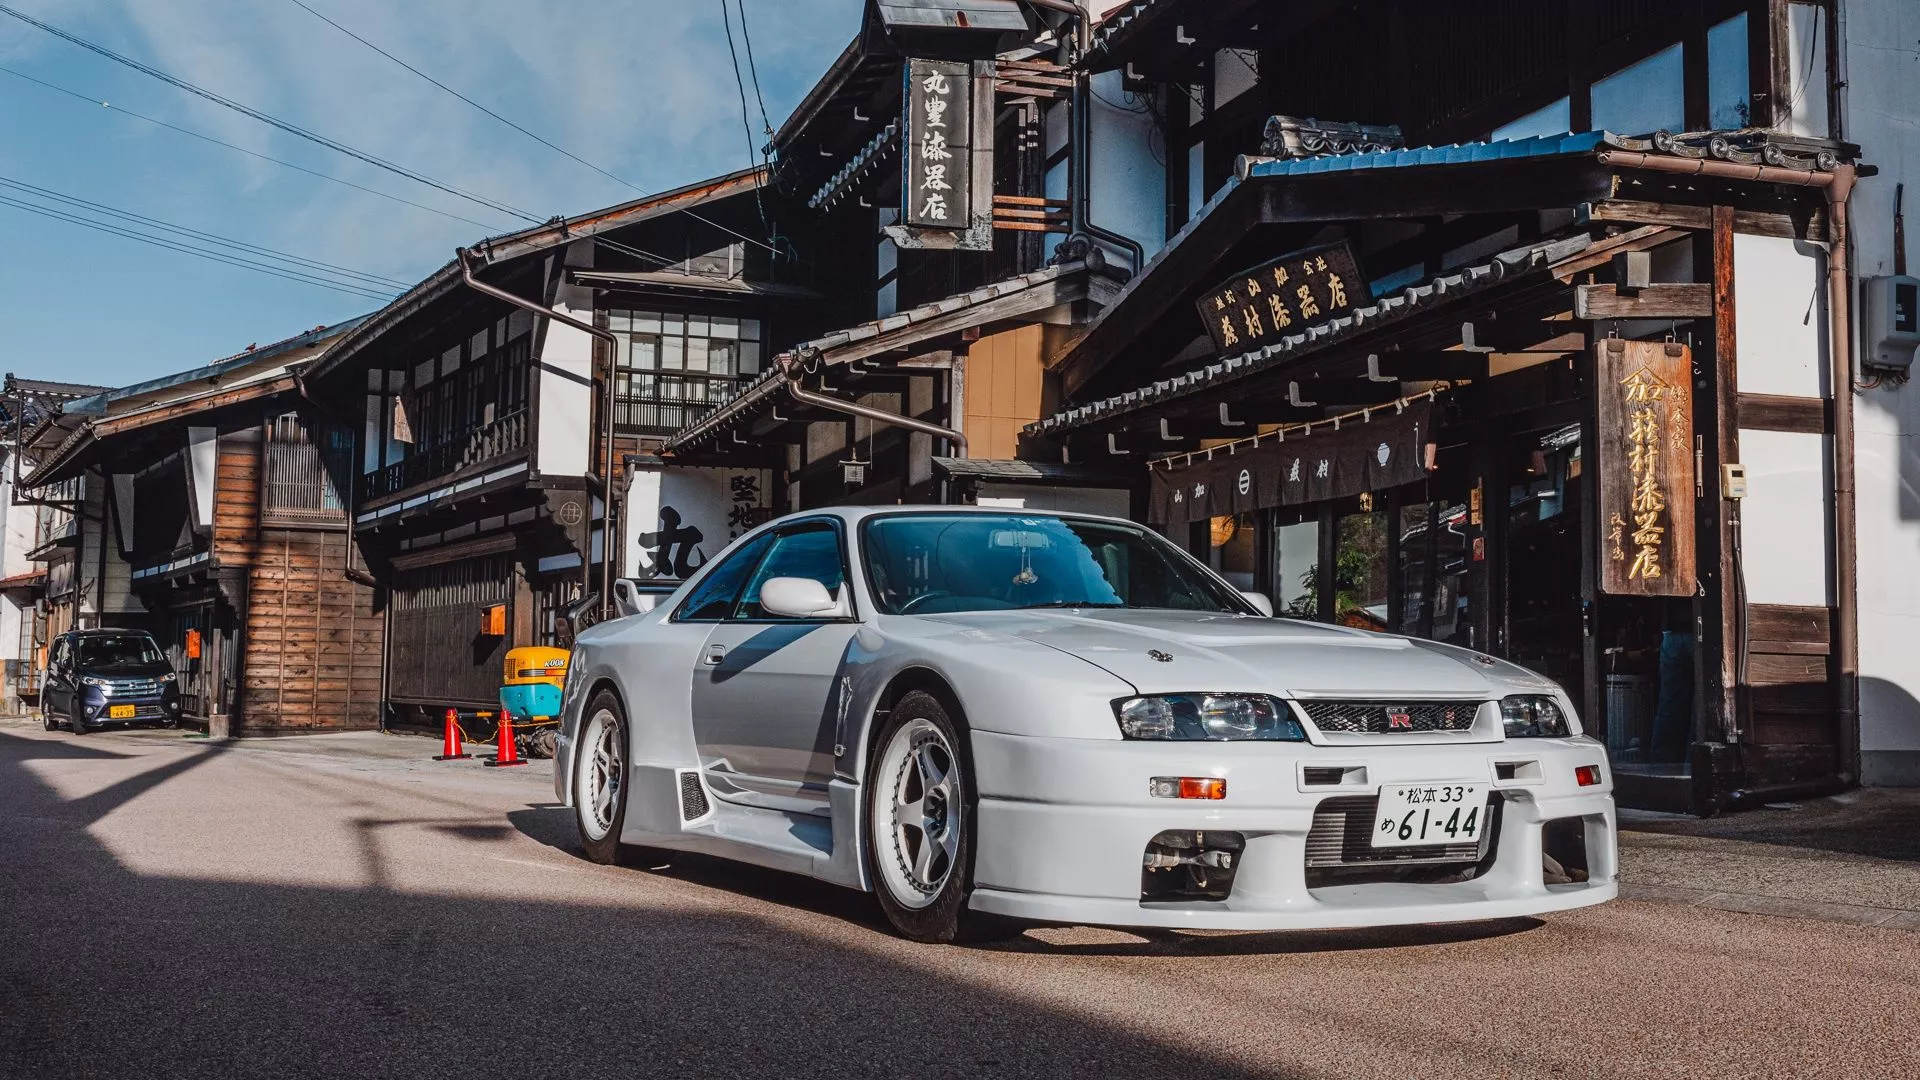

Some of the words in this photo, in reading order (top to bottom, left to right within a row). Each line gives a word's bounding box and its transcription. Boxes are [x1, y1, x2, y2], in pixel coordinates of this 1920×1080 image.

[638, 505, 708, 579] 丸
[1406, 787, 1437, 804] 松本
[1440, 786, 1464, 803] 33
[1381, 818, 1395, 834] め
[1398, 806, 1478, 841] 61-44
